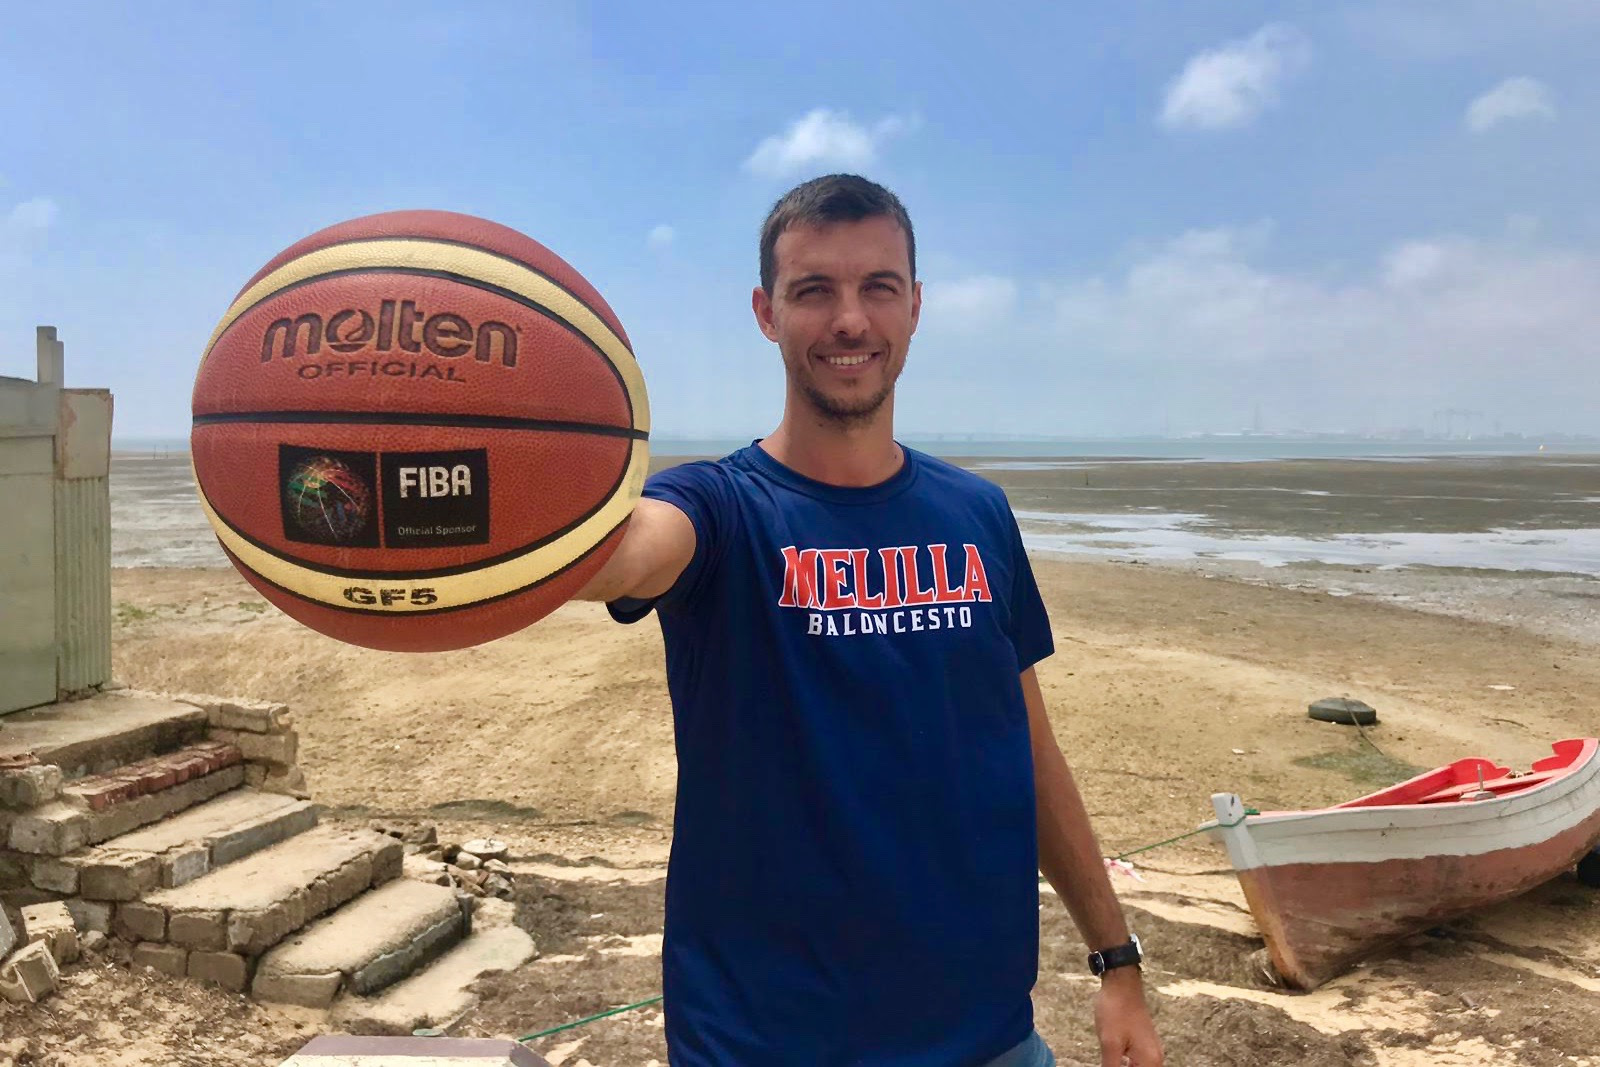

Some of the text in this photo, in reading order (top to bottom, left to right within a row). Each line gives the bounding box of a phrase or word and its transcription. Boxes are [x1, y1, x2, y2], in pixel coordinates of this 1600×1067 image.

[261, 299, 517, 368] molten
[298, 361, 466, 382] OFFICIAL
[400, 464, 472, 499] FIBA
[398, 524, 476, 536] Official Sponsor
[778, 544, 992, 611] MELILLA
[343, 586, 438, 606] GF5
[807, 606, 972, 636] BALONCESTO
